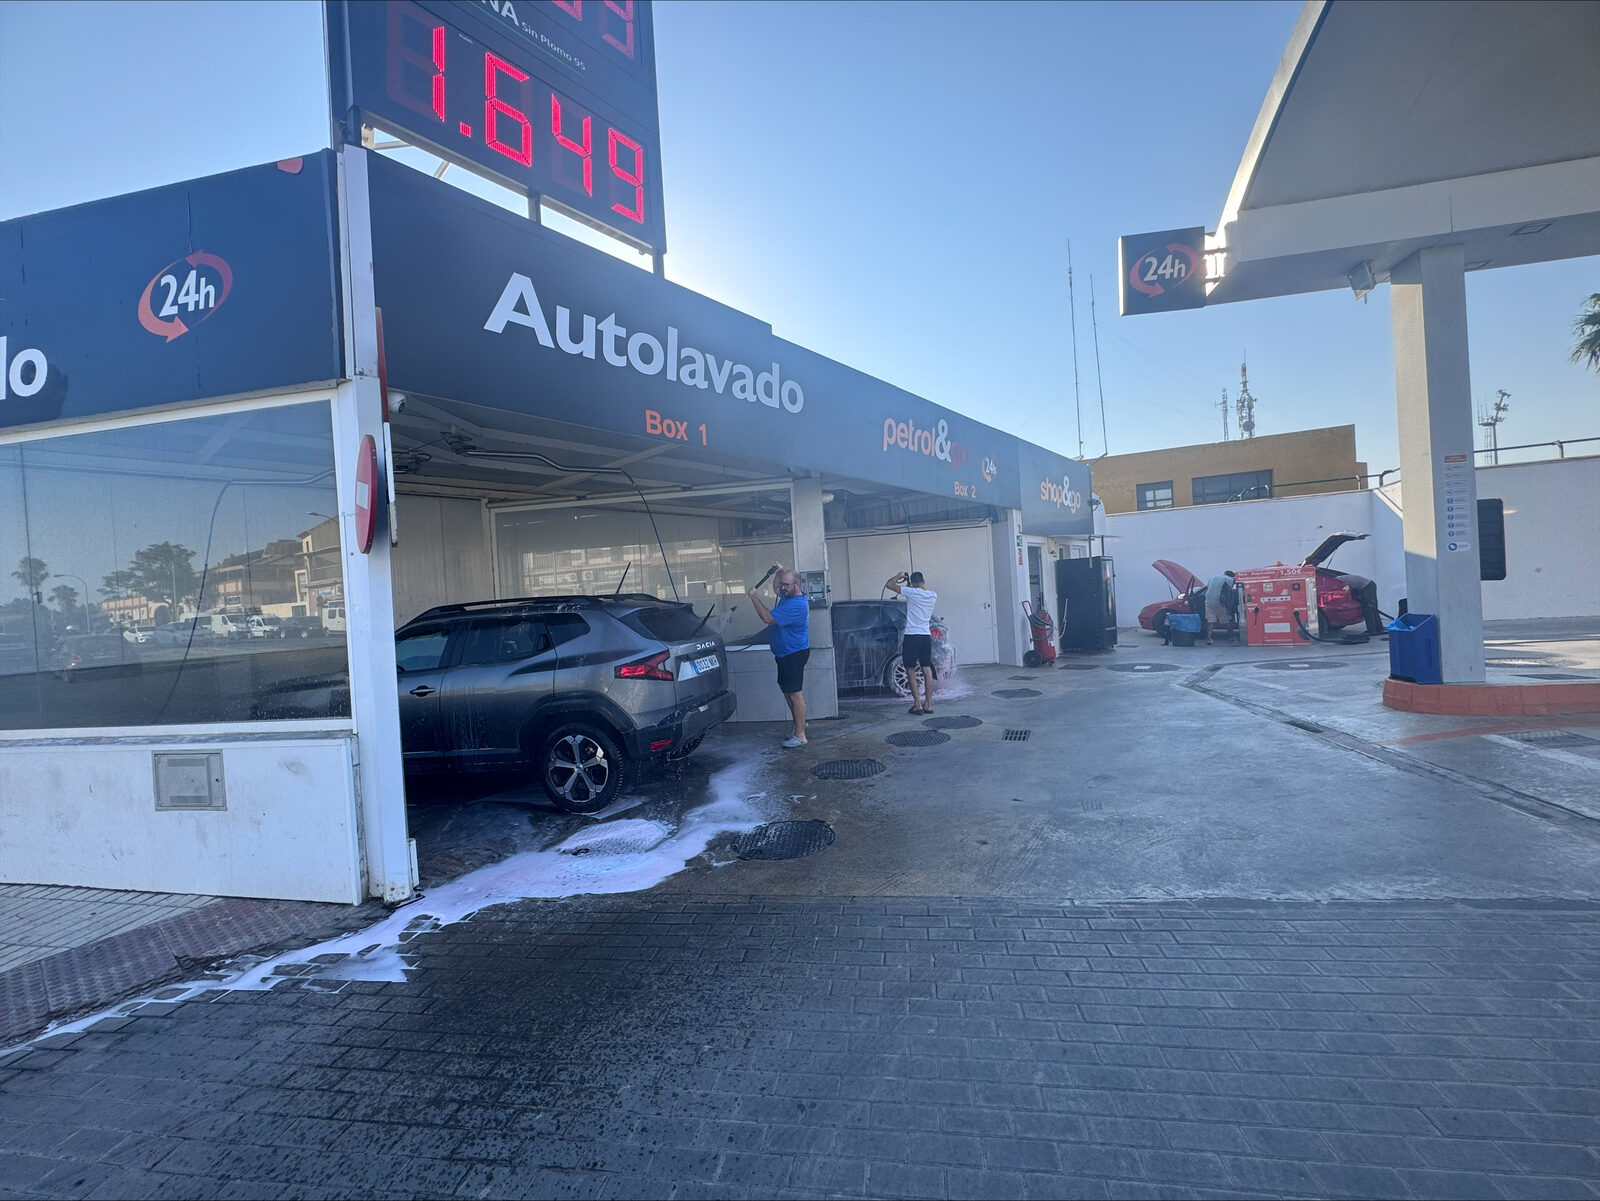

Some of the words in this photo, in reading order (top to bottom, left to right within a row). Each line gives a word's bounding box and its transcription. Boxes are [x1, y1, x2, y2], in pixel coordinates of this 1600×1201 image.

[521, 21, 539, 39] Sin
[540, 34, 572, 62] Plomo
[573, 57, 586, 71] 95
[432, 26, 644, 224] 1.649
[1143, 254, 1186, 281] 24h
[159, 269, 216, 318] 24h
[483, 272, 805, 414] Autolavado
[645, 409, 689, 441] Box
[698, 423, 708, 446] 1
[985, 457, 997, 476] 24h
[954, 480, 969, 497] Box
[971, 484, 977, 499] 2
[1040, 475, 1081, 514] shop&go
[696, 641, 716, 651] DACIA
